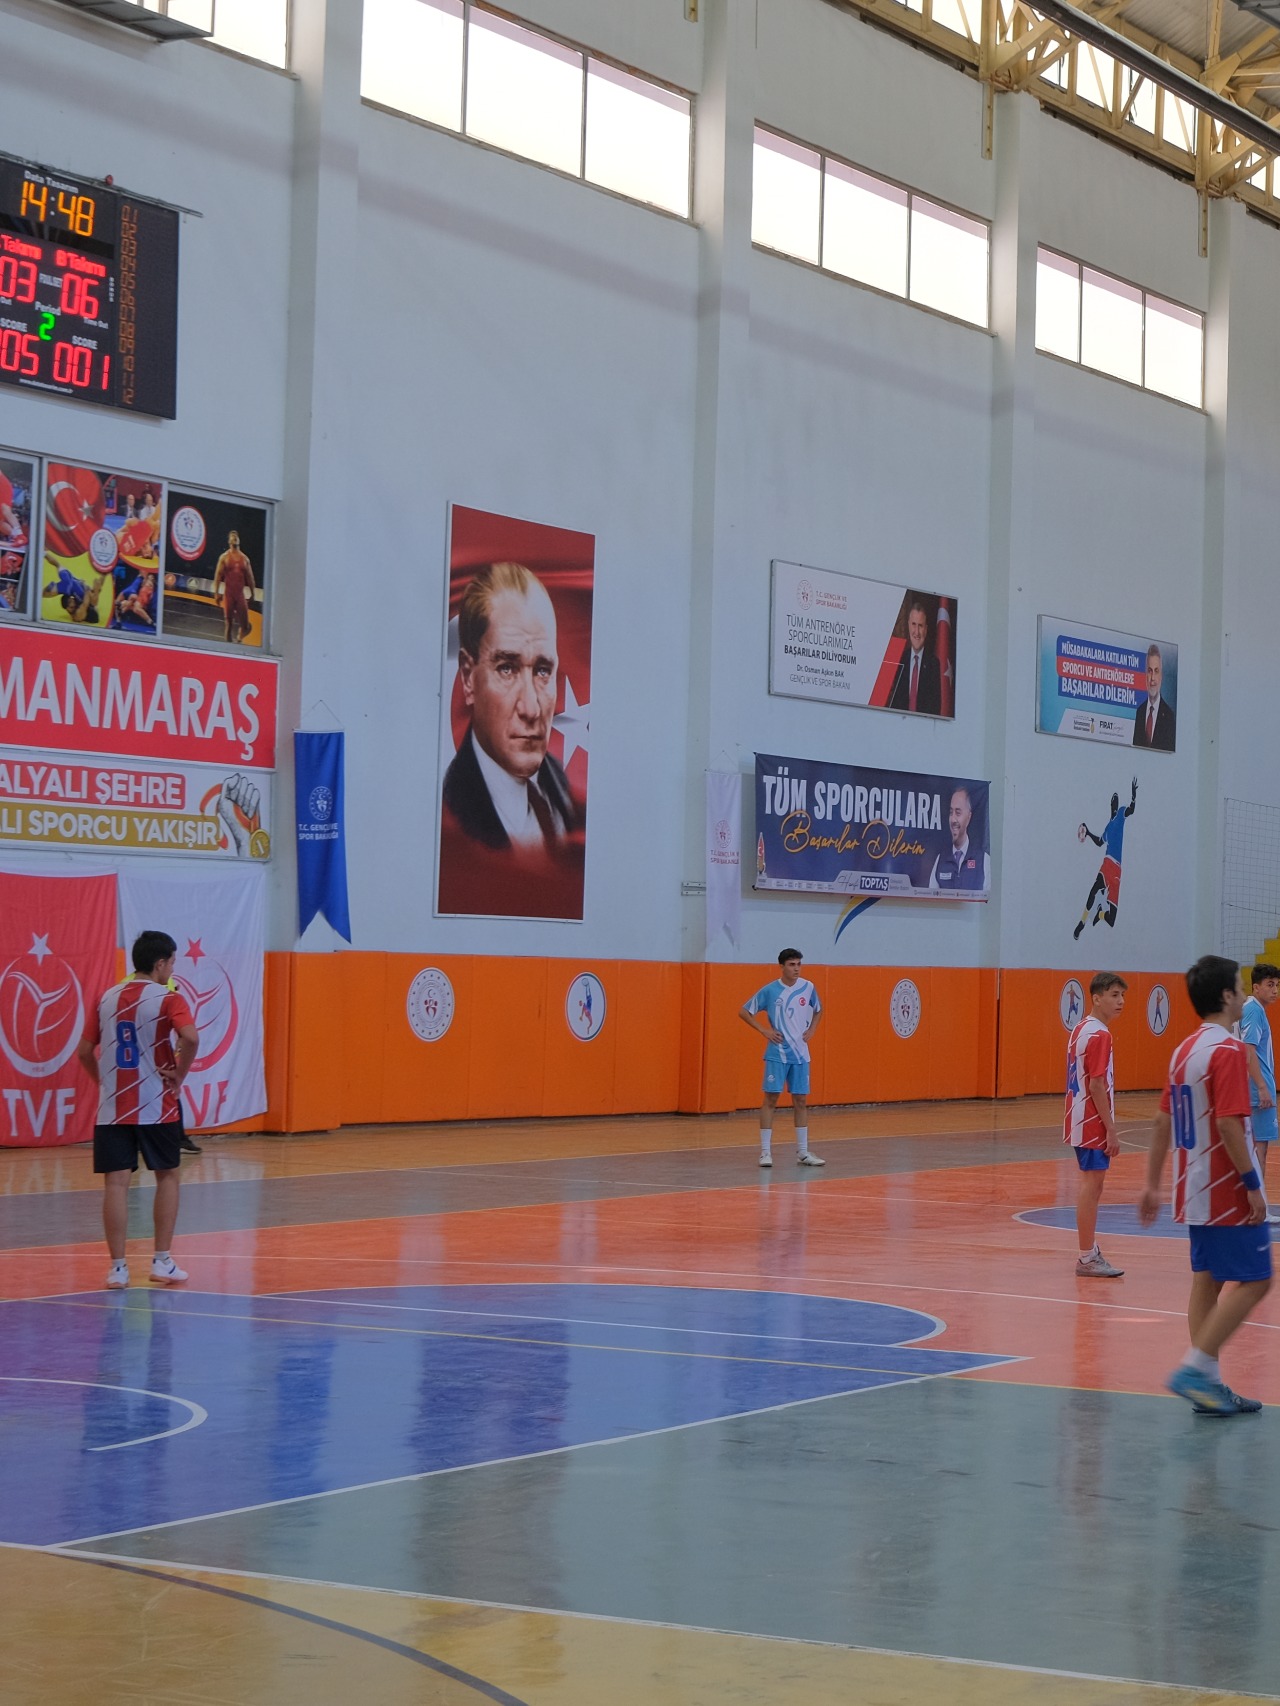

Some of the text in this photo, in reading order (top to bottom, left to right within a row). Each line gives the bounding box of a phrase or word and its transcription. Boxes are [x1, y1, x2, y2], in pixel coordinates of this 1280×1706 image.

[20, 180, 96, 237] 14:48
[0, 255, 38, 303] 03
[61, 272, 100, 320] 06
[38, 311, 56, 341] 2
[72, 335, 98, 350] SCORE
[786, 613, 856, 638] TÜM ANTRENÖR VE
[788, 629, 853, 651] SPORCULARIMIZA
[784, 644, 857, 665] BAŞARILAR DİLİYORUM
[1061, 640, 1140, 669] MÜSABAKALARA KATILAN TÜM
[1062, 661, 1085, 676] SPORCU
[1085, 665, 1093, 678] VE
[1061, 676, 1138, 706] BAŞARILAR DİLERİM.
[95, 771, 182, 806] ŞEHRE
[762, 766, 942, 831] TÜM SPORCULARA
[28, 810, 127, 841] SPORCU
[133, 817, 218, 848] YAKIŞIR
[861, 876, 888, 891] TOPTAŞ
[116, 1020, 140, 1069] 8
[2, 1087, 76, 1137] TVF
[182, 1080, 230, 1127] VF
